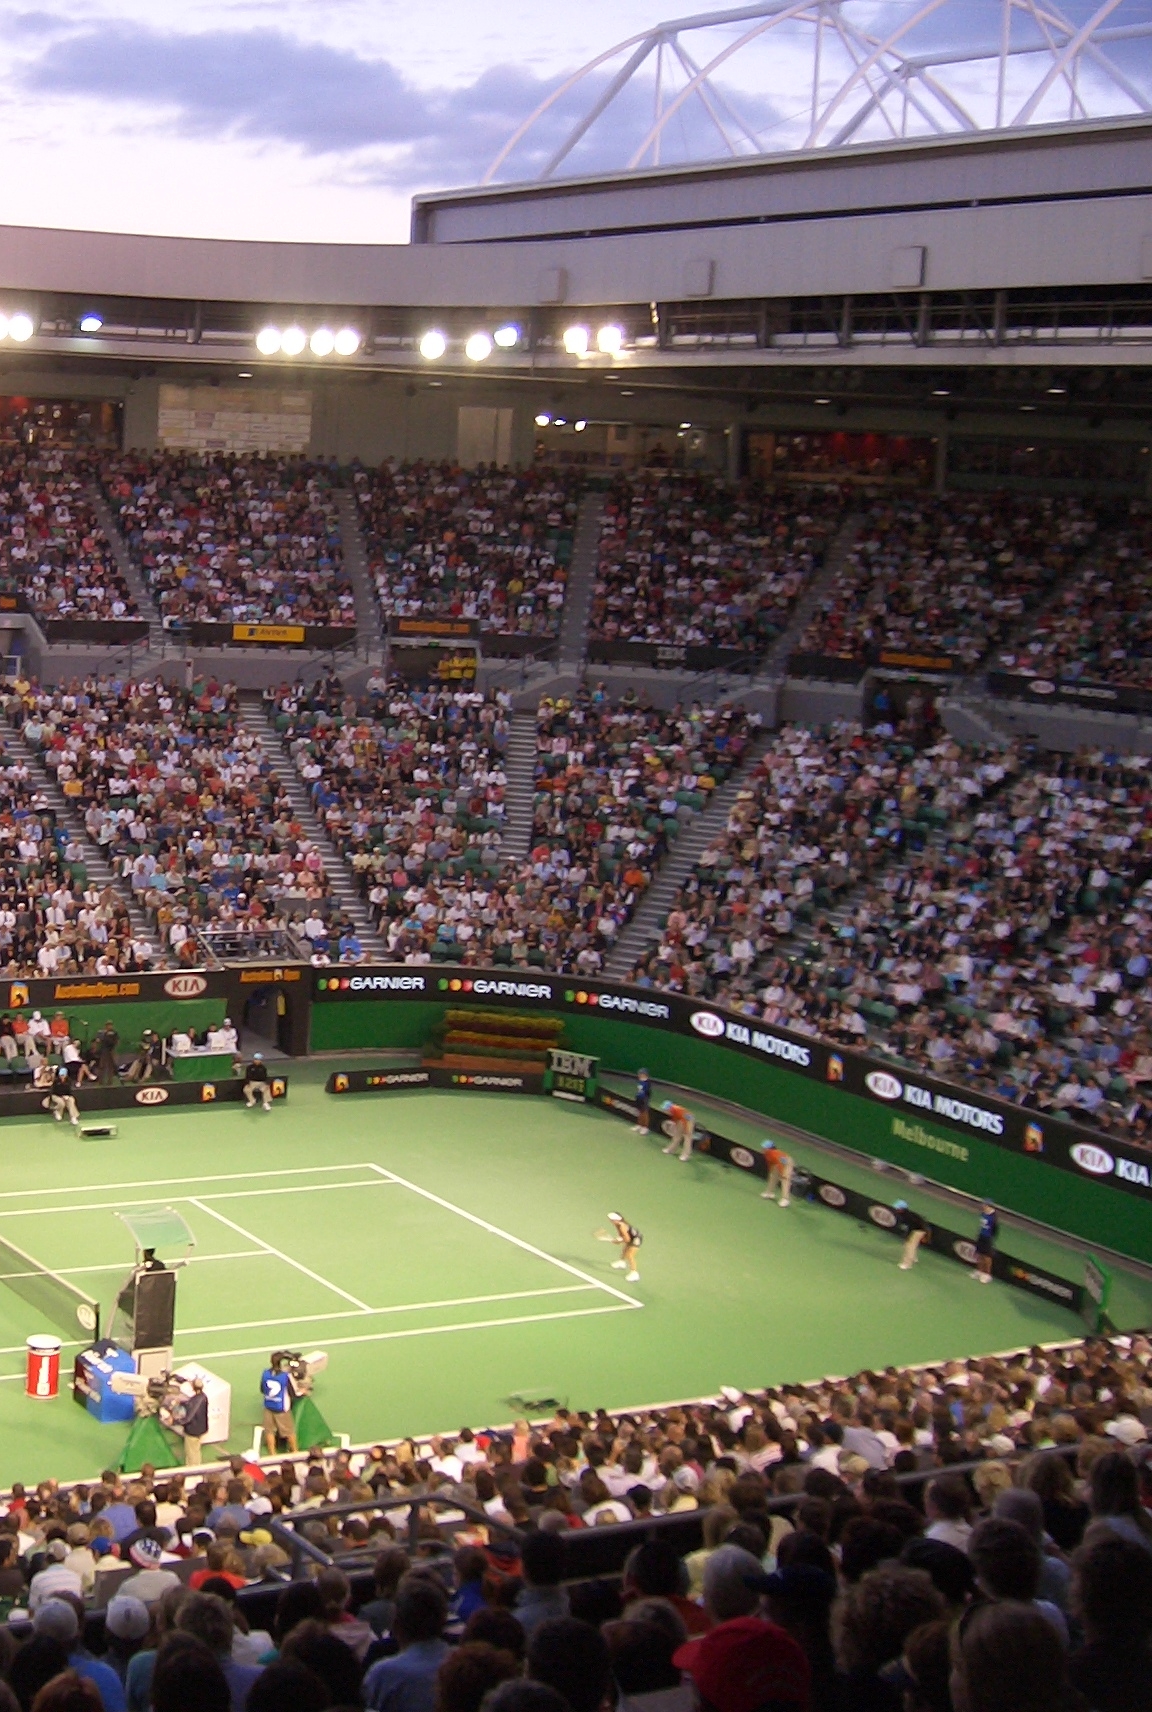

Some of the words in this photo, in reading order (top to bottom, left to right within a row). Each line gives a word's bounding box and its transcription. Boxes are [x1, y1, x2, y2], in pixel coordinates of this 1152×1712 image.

[350, 977, 425, 990] GARNIER
[473, 980, 552, 999] GARNIER
[598, 994, 670, 1019] GARNIER
[726, 1021, 750, 1046] KIA
[751, 1030, 811, 1067] MOTORS
[551, 1051, 592, 1078] IBM
[903, 1083, 933, 1111] KIA
[934, 1094, 1004, 1135] MOTORS
[891, 1117, 969, 1163] Melbourne
[1115, 1157, 1149, 1187] KIA
